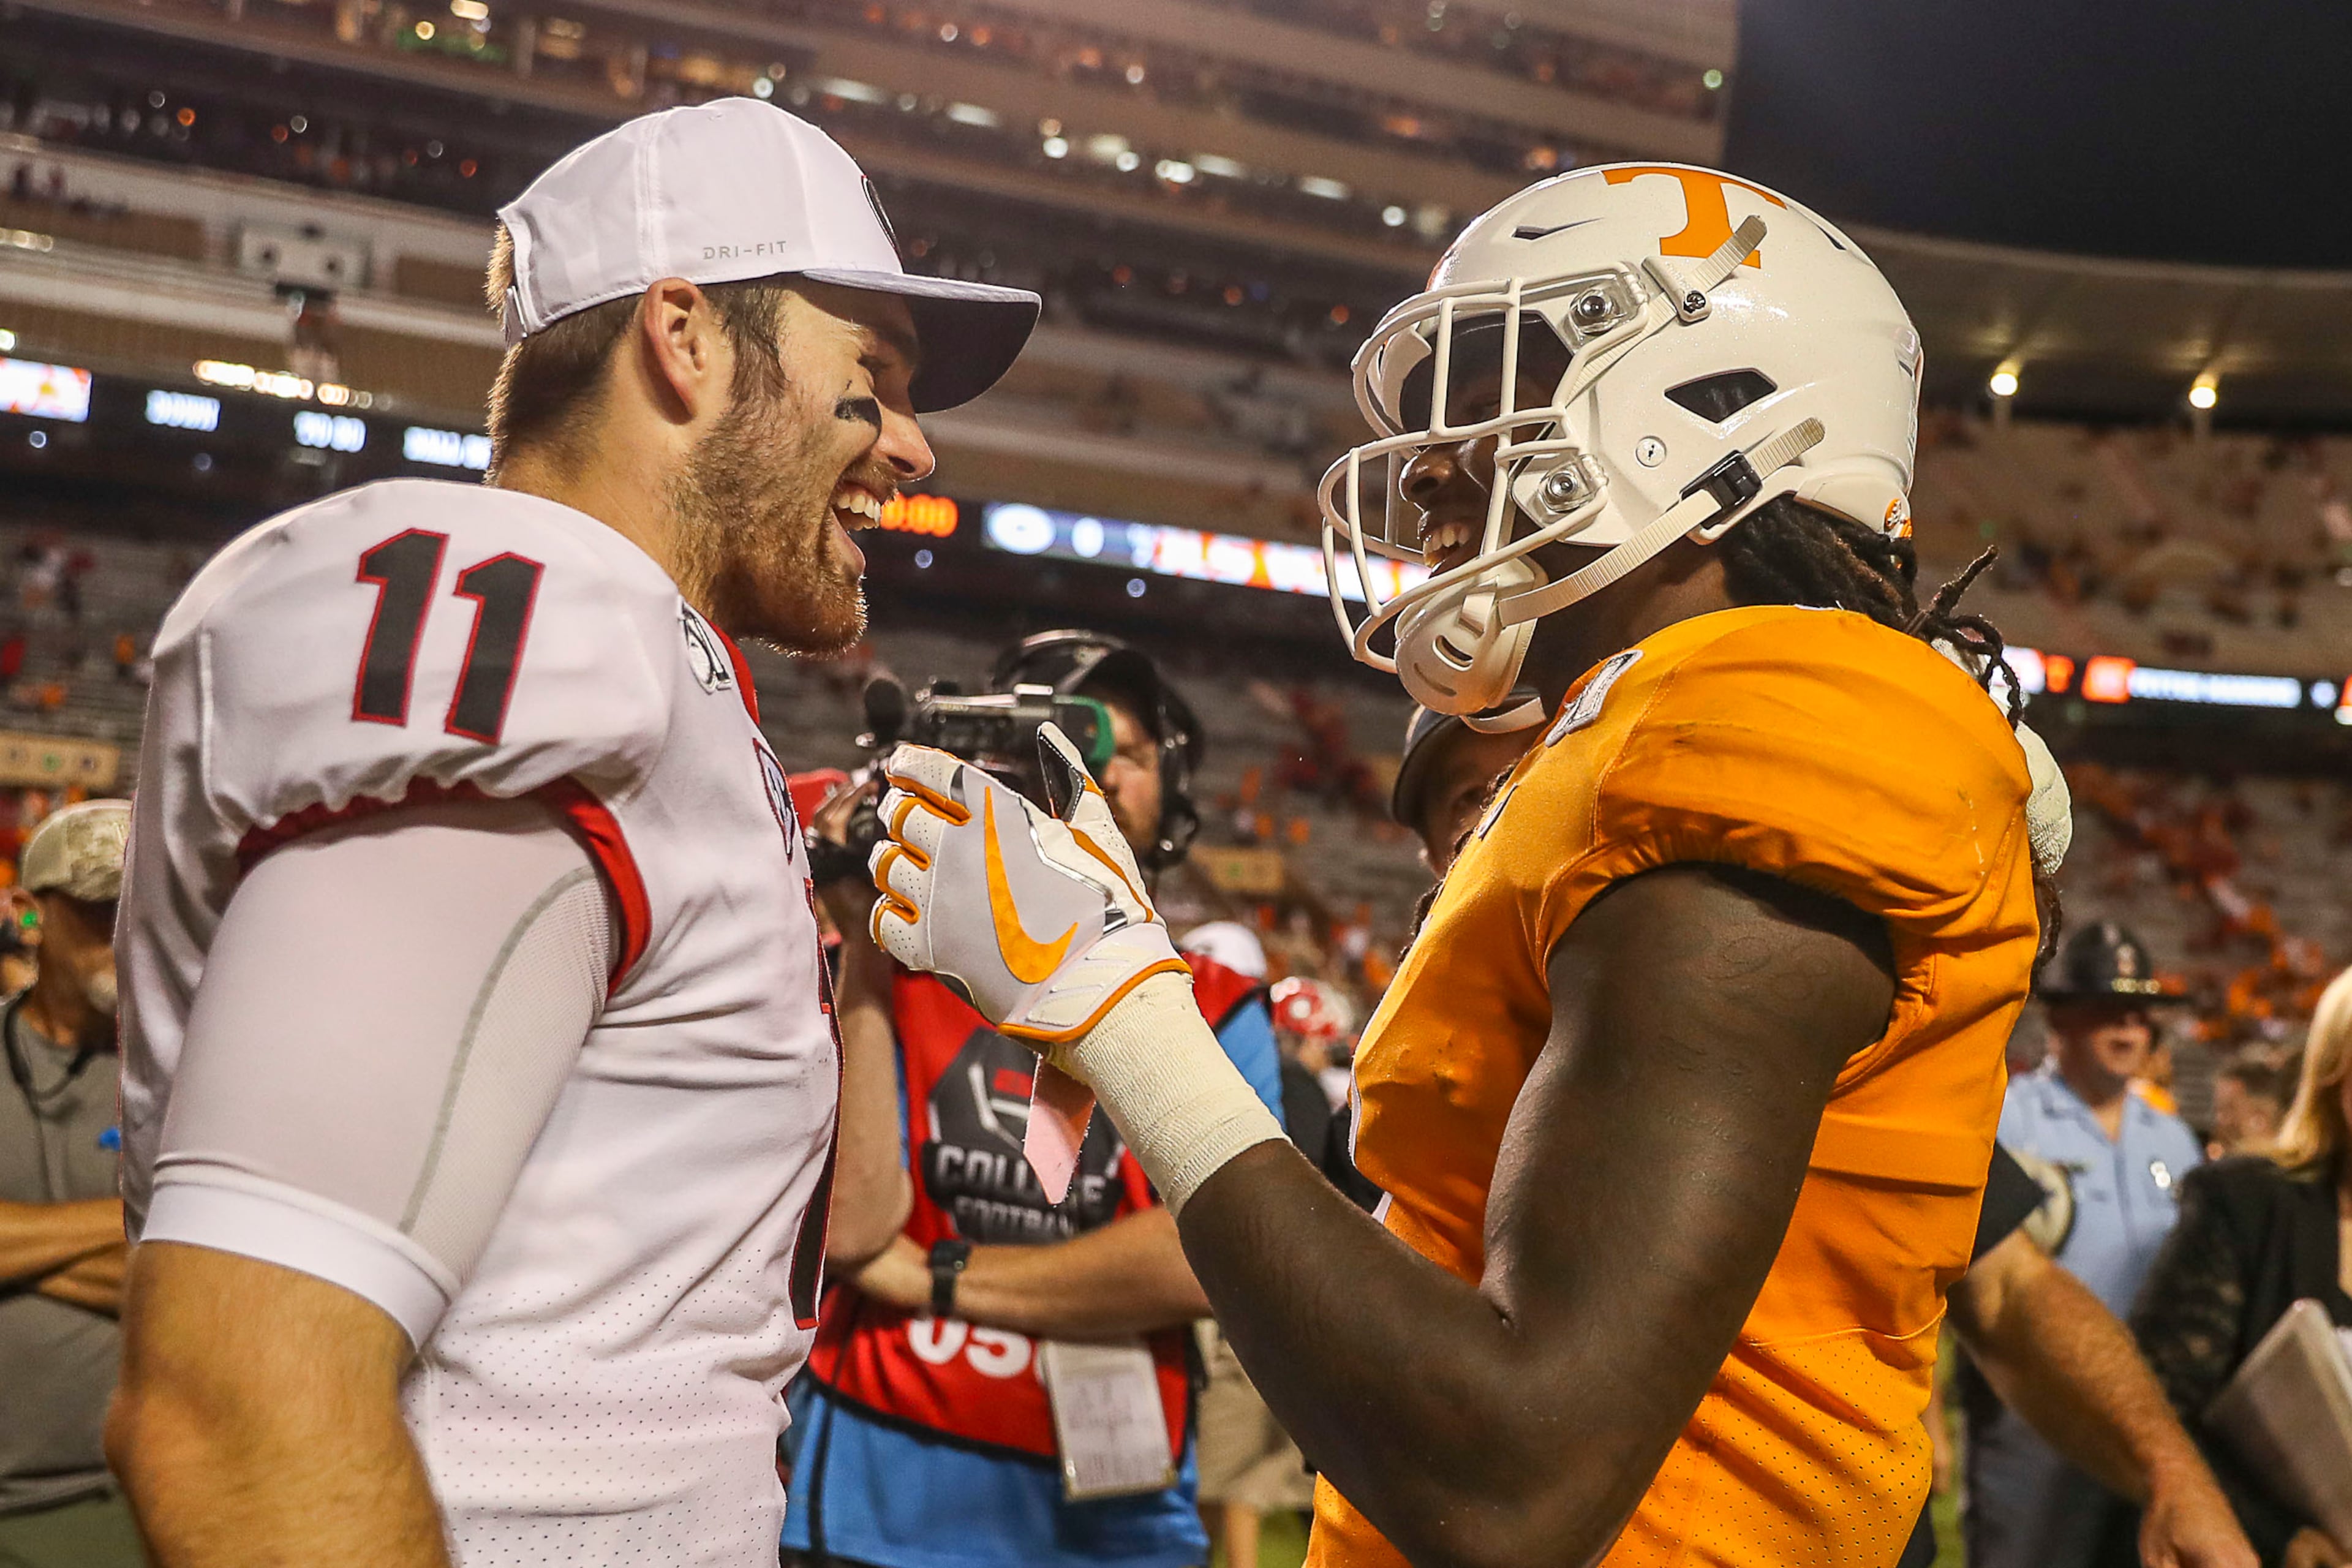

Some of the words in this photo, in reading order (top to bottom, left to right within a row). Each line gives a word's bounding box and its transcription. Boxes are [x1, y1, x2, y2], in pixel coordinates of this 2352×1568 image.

[703, 241, 786, 260] DRI-FIT
[351, 527, 545, 746] 11
[935, 1143, 1107, 1215] COLLE
